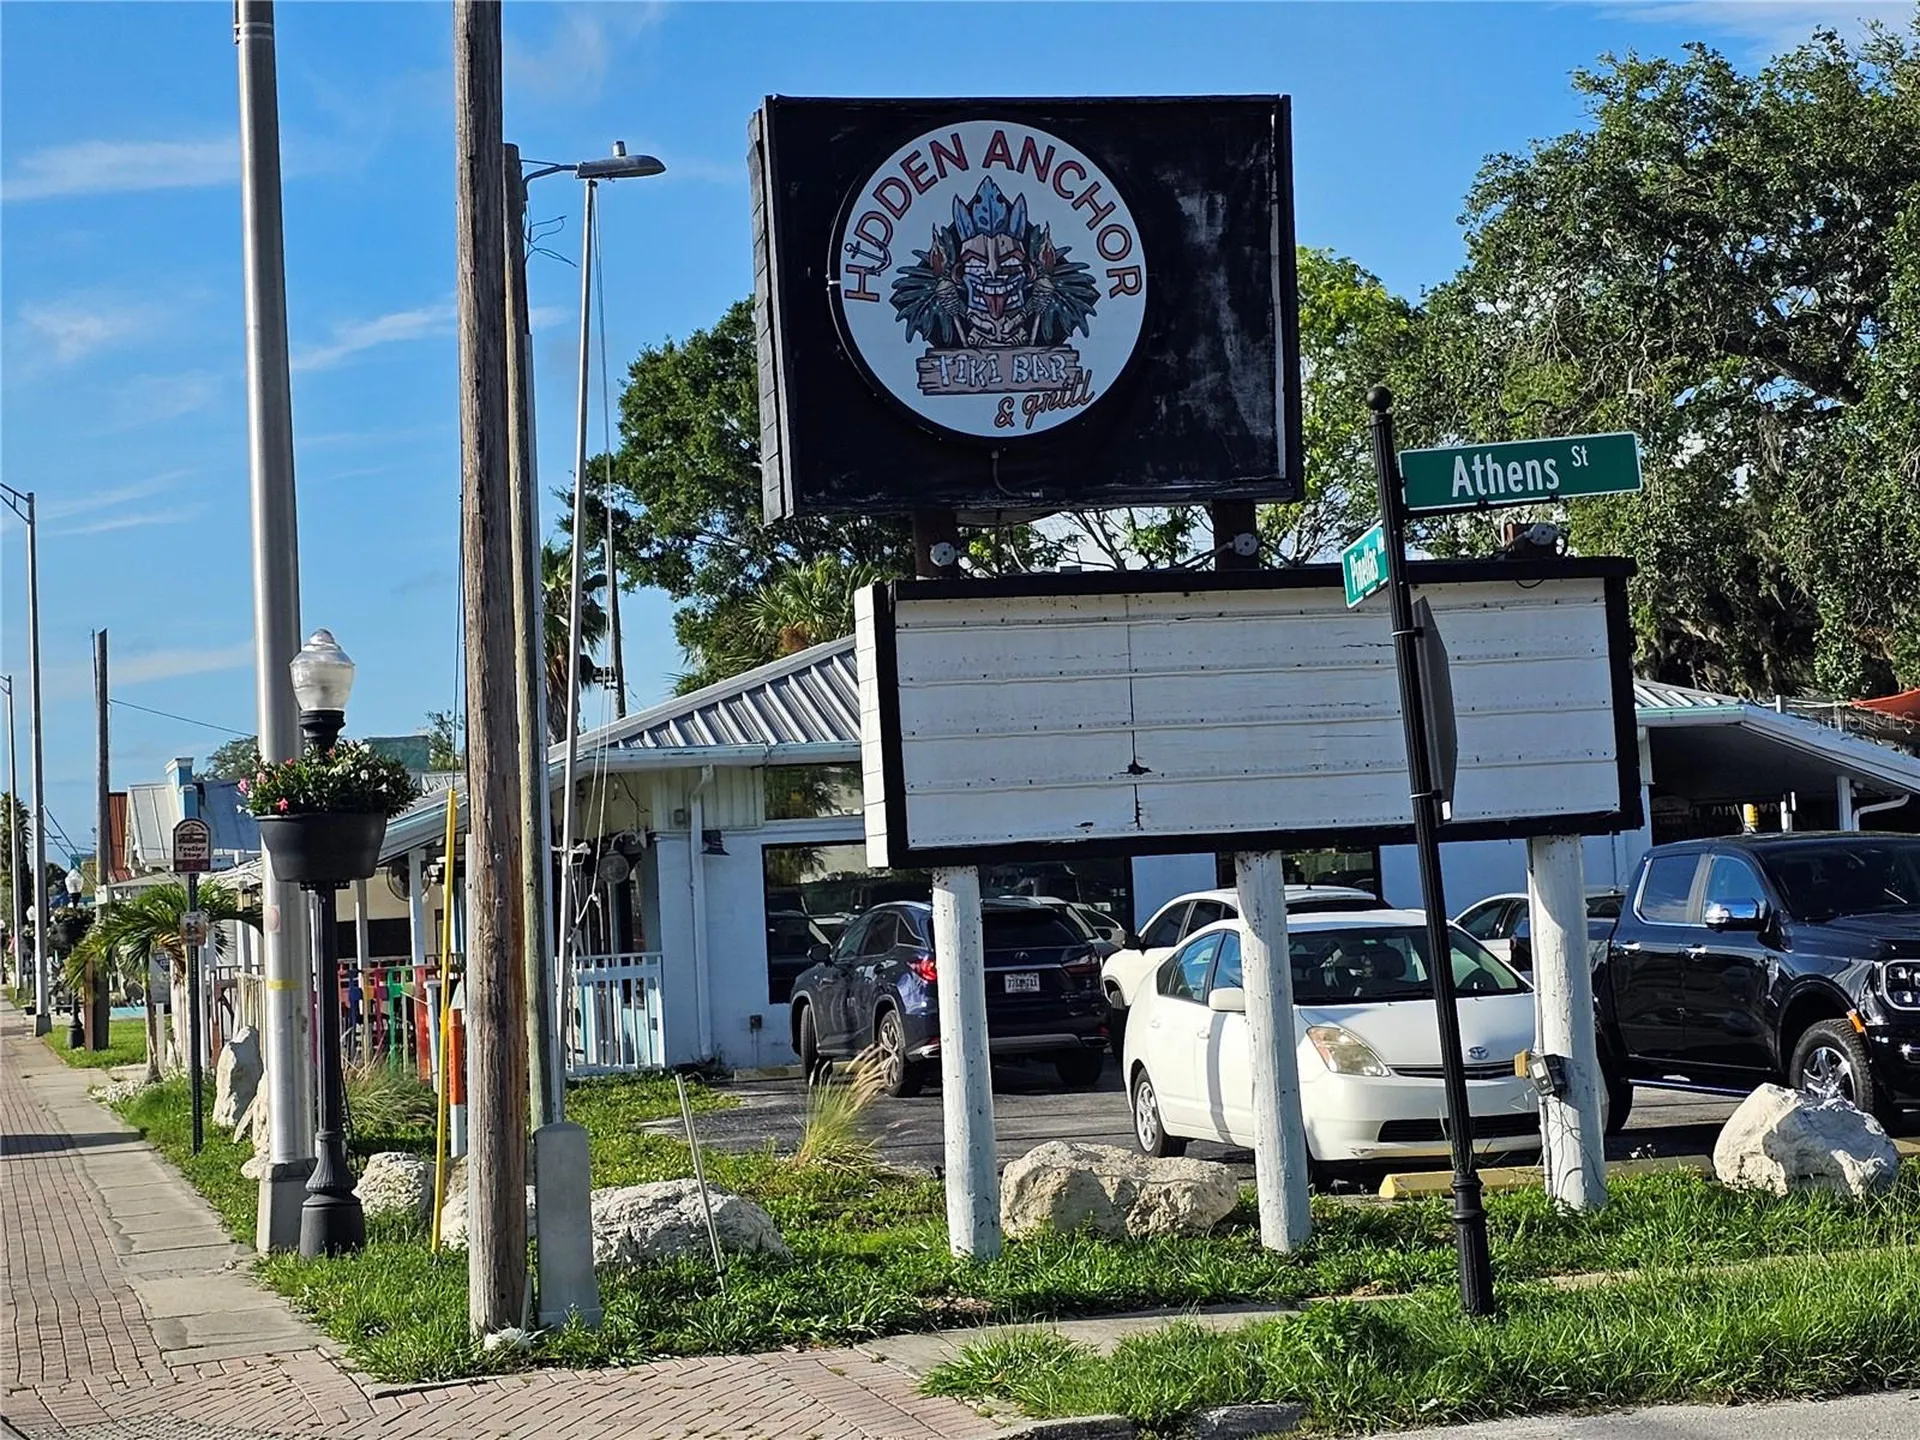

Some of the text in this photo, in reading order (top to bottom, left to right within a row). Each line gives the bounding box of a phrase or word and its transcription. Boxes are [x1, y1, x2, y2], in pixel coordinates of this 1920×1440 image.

[982, 130, 1143, 299] ANCHOR
[935, 354, 1070, 388] TIKI BAR
[993, 369, 1096, 430] & grill
[1451, 445, 1590, 498] Athens St
